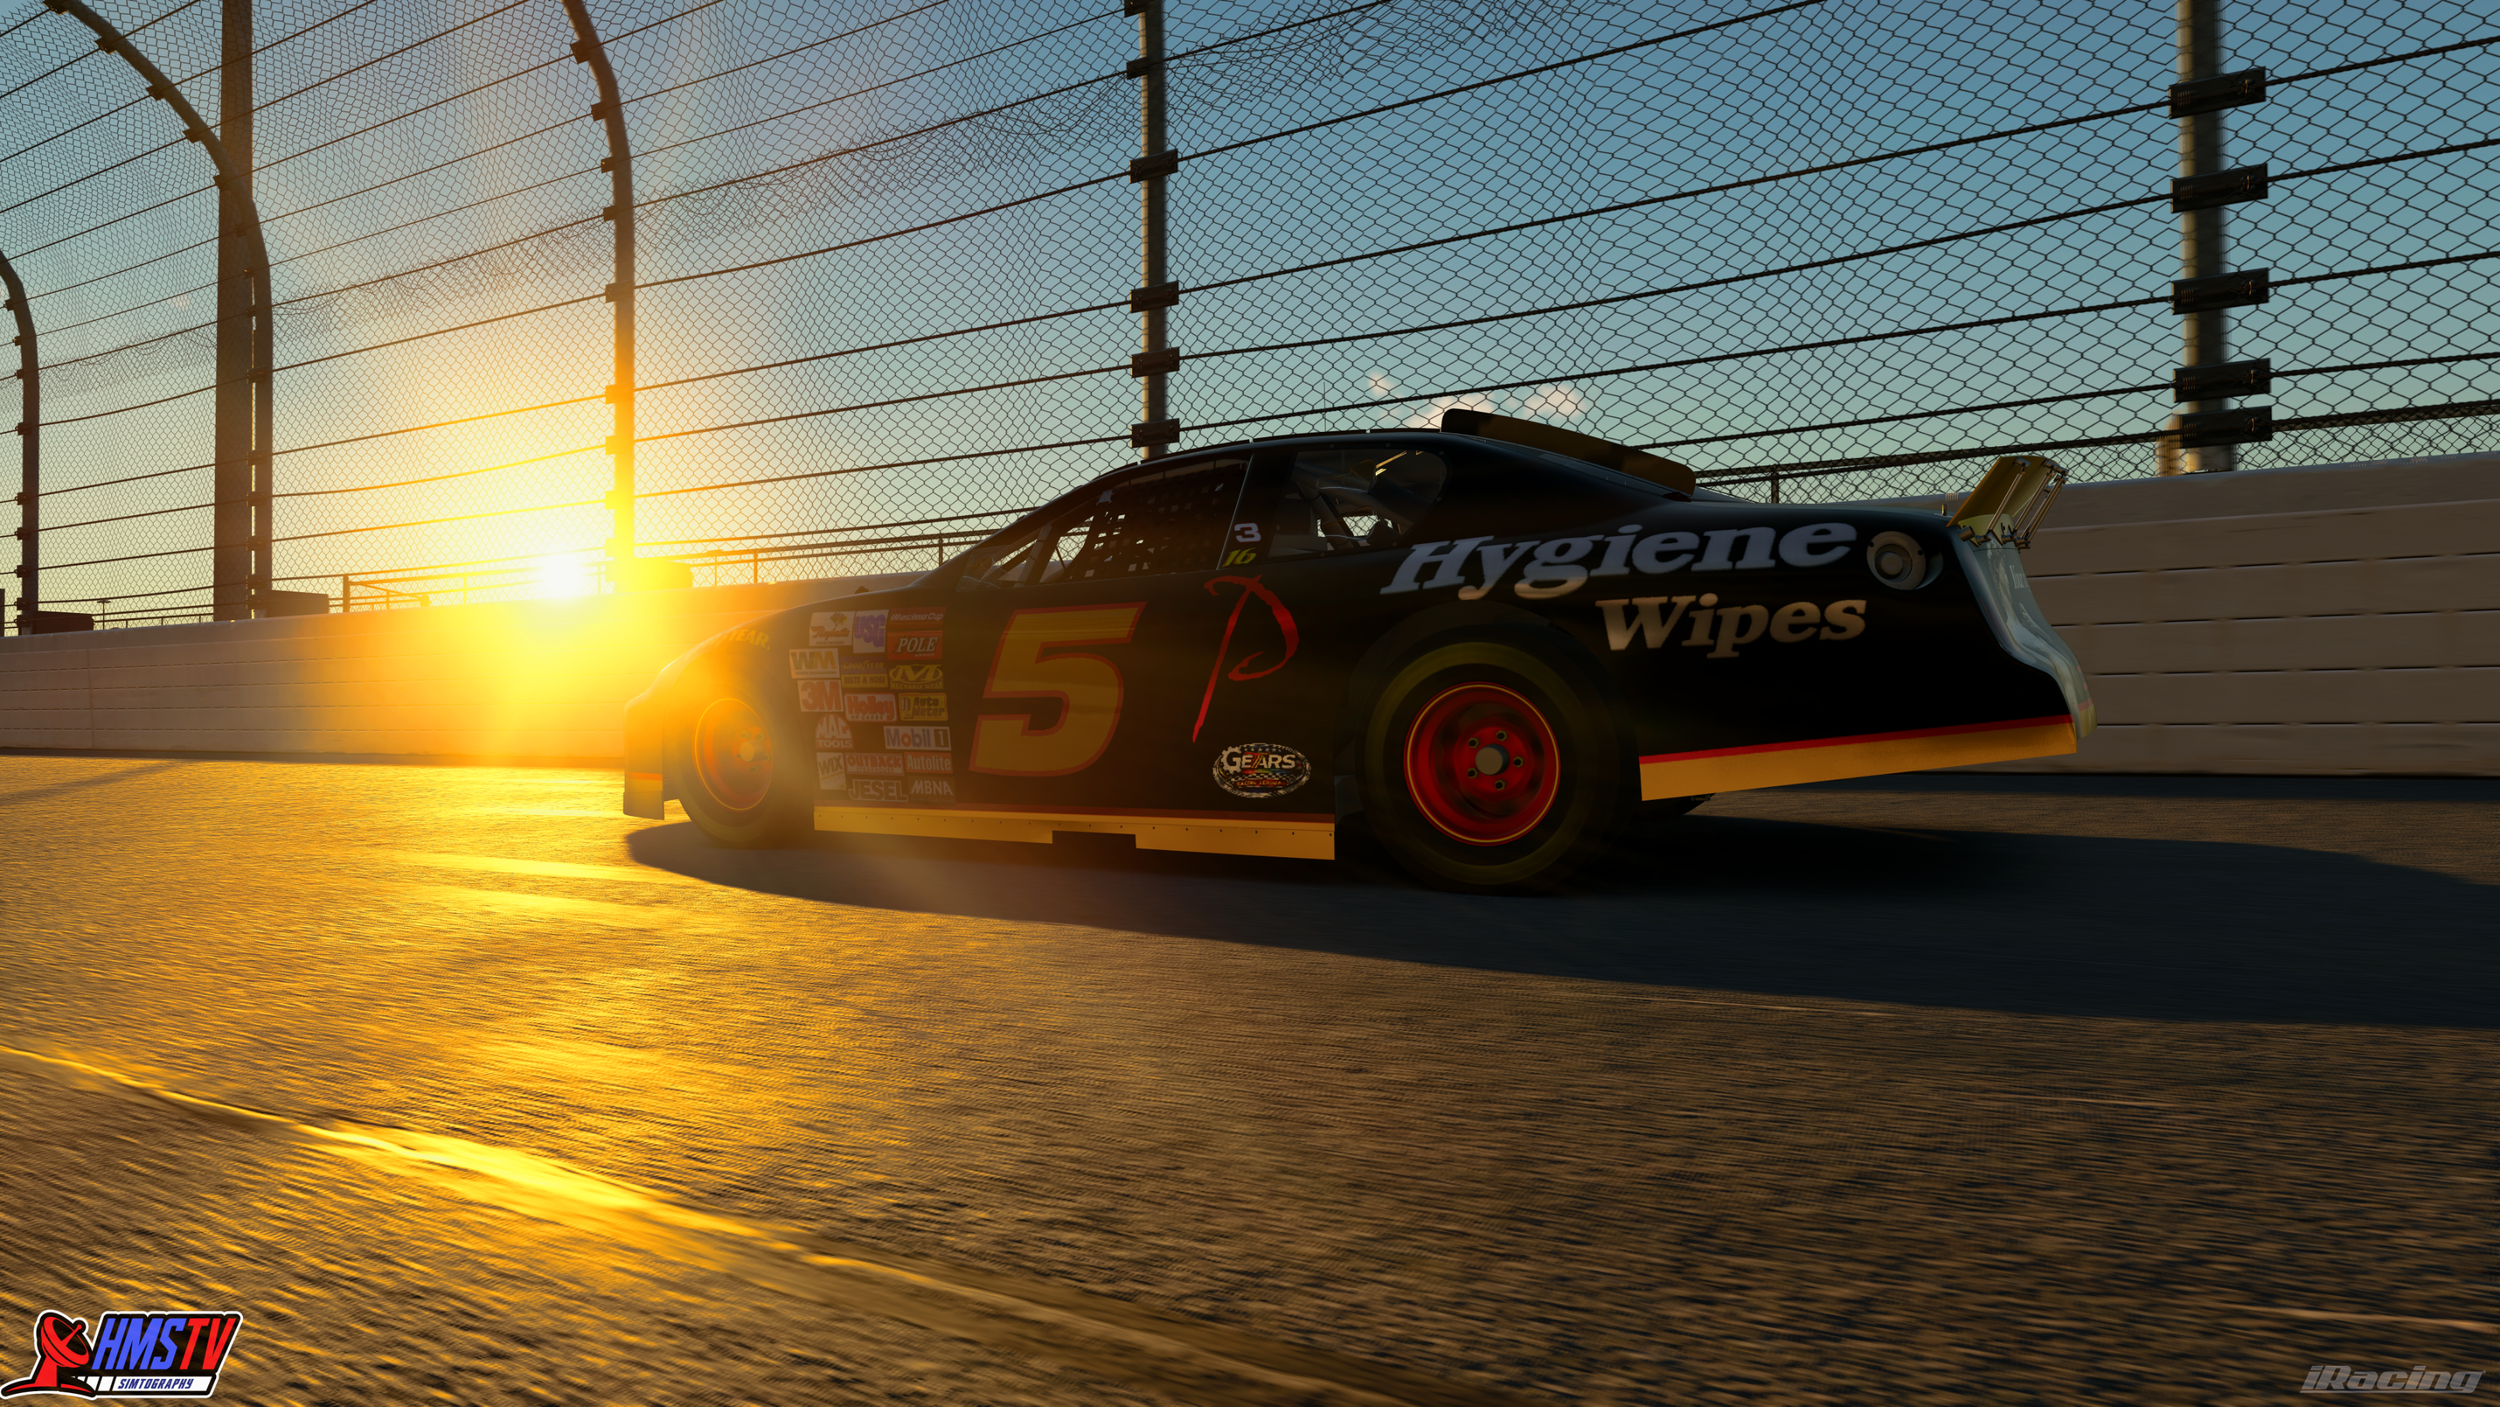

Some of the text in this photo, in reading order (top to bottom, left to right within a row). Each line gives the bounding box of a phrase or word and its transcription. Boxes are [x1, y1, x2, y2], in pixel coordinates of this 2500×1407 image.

[1233, 522, 1262, 543] 3
[1221, 547, 1257, 568] 16
[1380, 522, 1858, 600] Hygiene
[927, 612, 944, 622] Cup
[1594, 592, 1868, 659] Wipes
[854, 614, 886, 648] USG
[896, 636, 938, 653] POLE
[791, 651, 837, 670] WM
[843, 675, 886, 684] BELTS & HOSE
[924, 681, 944, 689] WEAR
[968, 601, 1148, 777] 5
[801, 681, 842, 711] 3M
[913, 696, 939, 707] Auto
[846, 695, 894, 721] Holley
[912, 706, 945, 717] Meter
[815, 714, 852, 739] MAC
[816, 739, 853, 748] TOOLS
[885, 728, 944, 747] Mobil 1
[818, 754, 844, 776] WIX
[847, 754, 902, 769] OUTBACK
[907, 754, 951, 771] Autolite
[1221, 746, 1296, 774] GEARS
[848, 778, 908, 802] JESEL
[910, 780, 954, 796] MBNA
